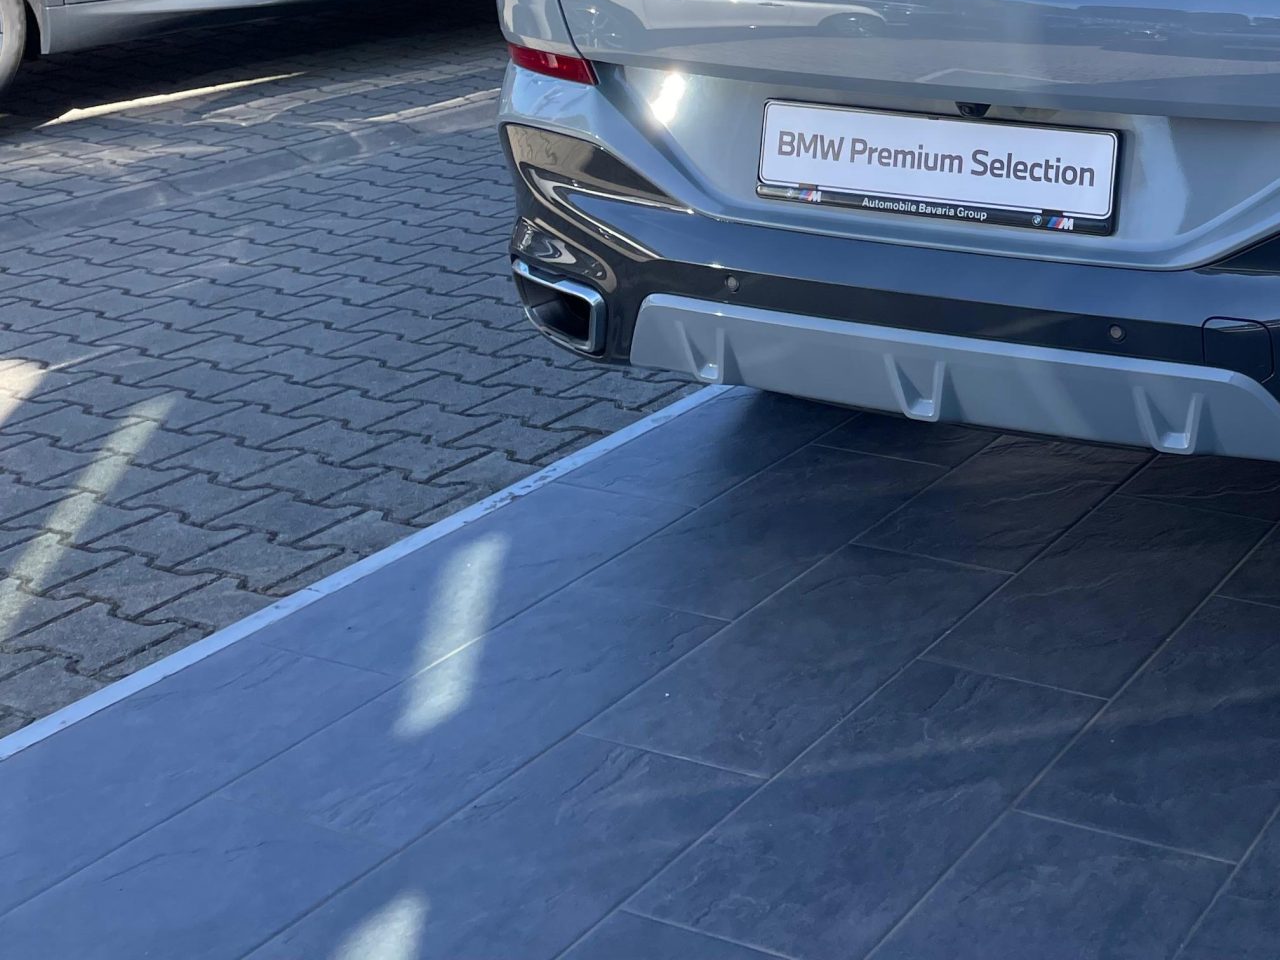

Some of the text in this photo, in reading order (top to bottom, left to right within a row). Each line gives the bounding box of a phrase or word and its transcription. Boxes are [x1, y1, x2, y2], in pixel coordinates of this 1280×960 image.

[777, 130, 1096, 188] BMW Premium Selection
[861, 197, 988, 221] Automobile Bavaria Group
